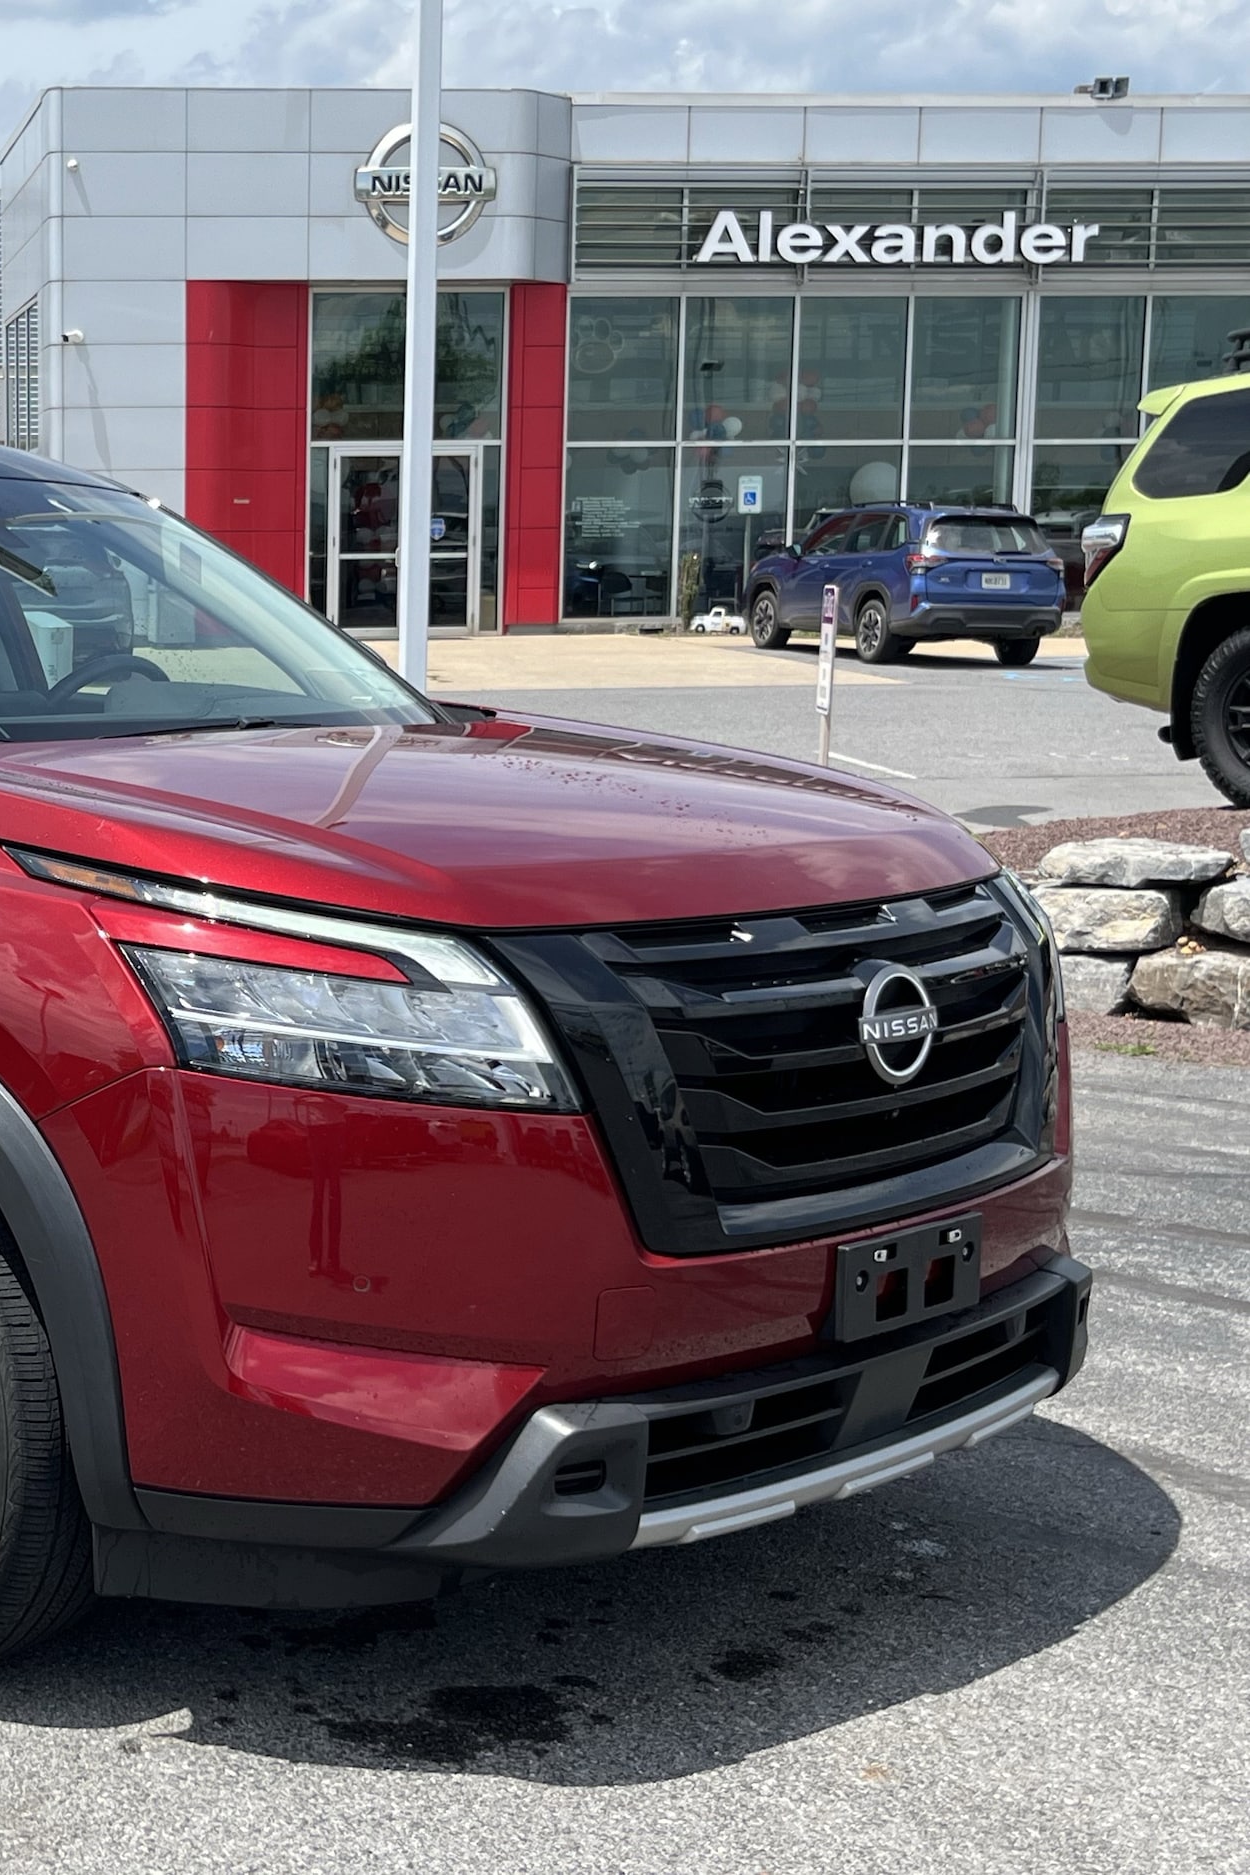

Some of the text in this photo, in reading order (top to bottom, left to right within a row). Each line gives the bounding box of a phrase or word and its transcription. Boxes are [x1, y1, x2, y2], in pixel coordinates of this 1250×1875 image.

[371, 172, 484, 195] NIAN
[696, 210, 1100, 264] Alexander
[862, 1012, 938, 1041] NISSAN
